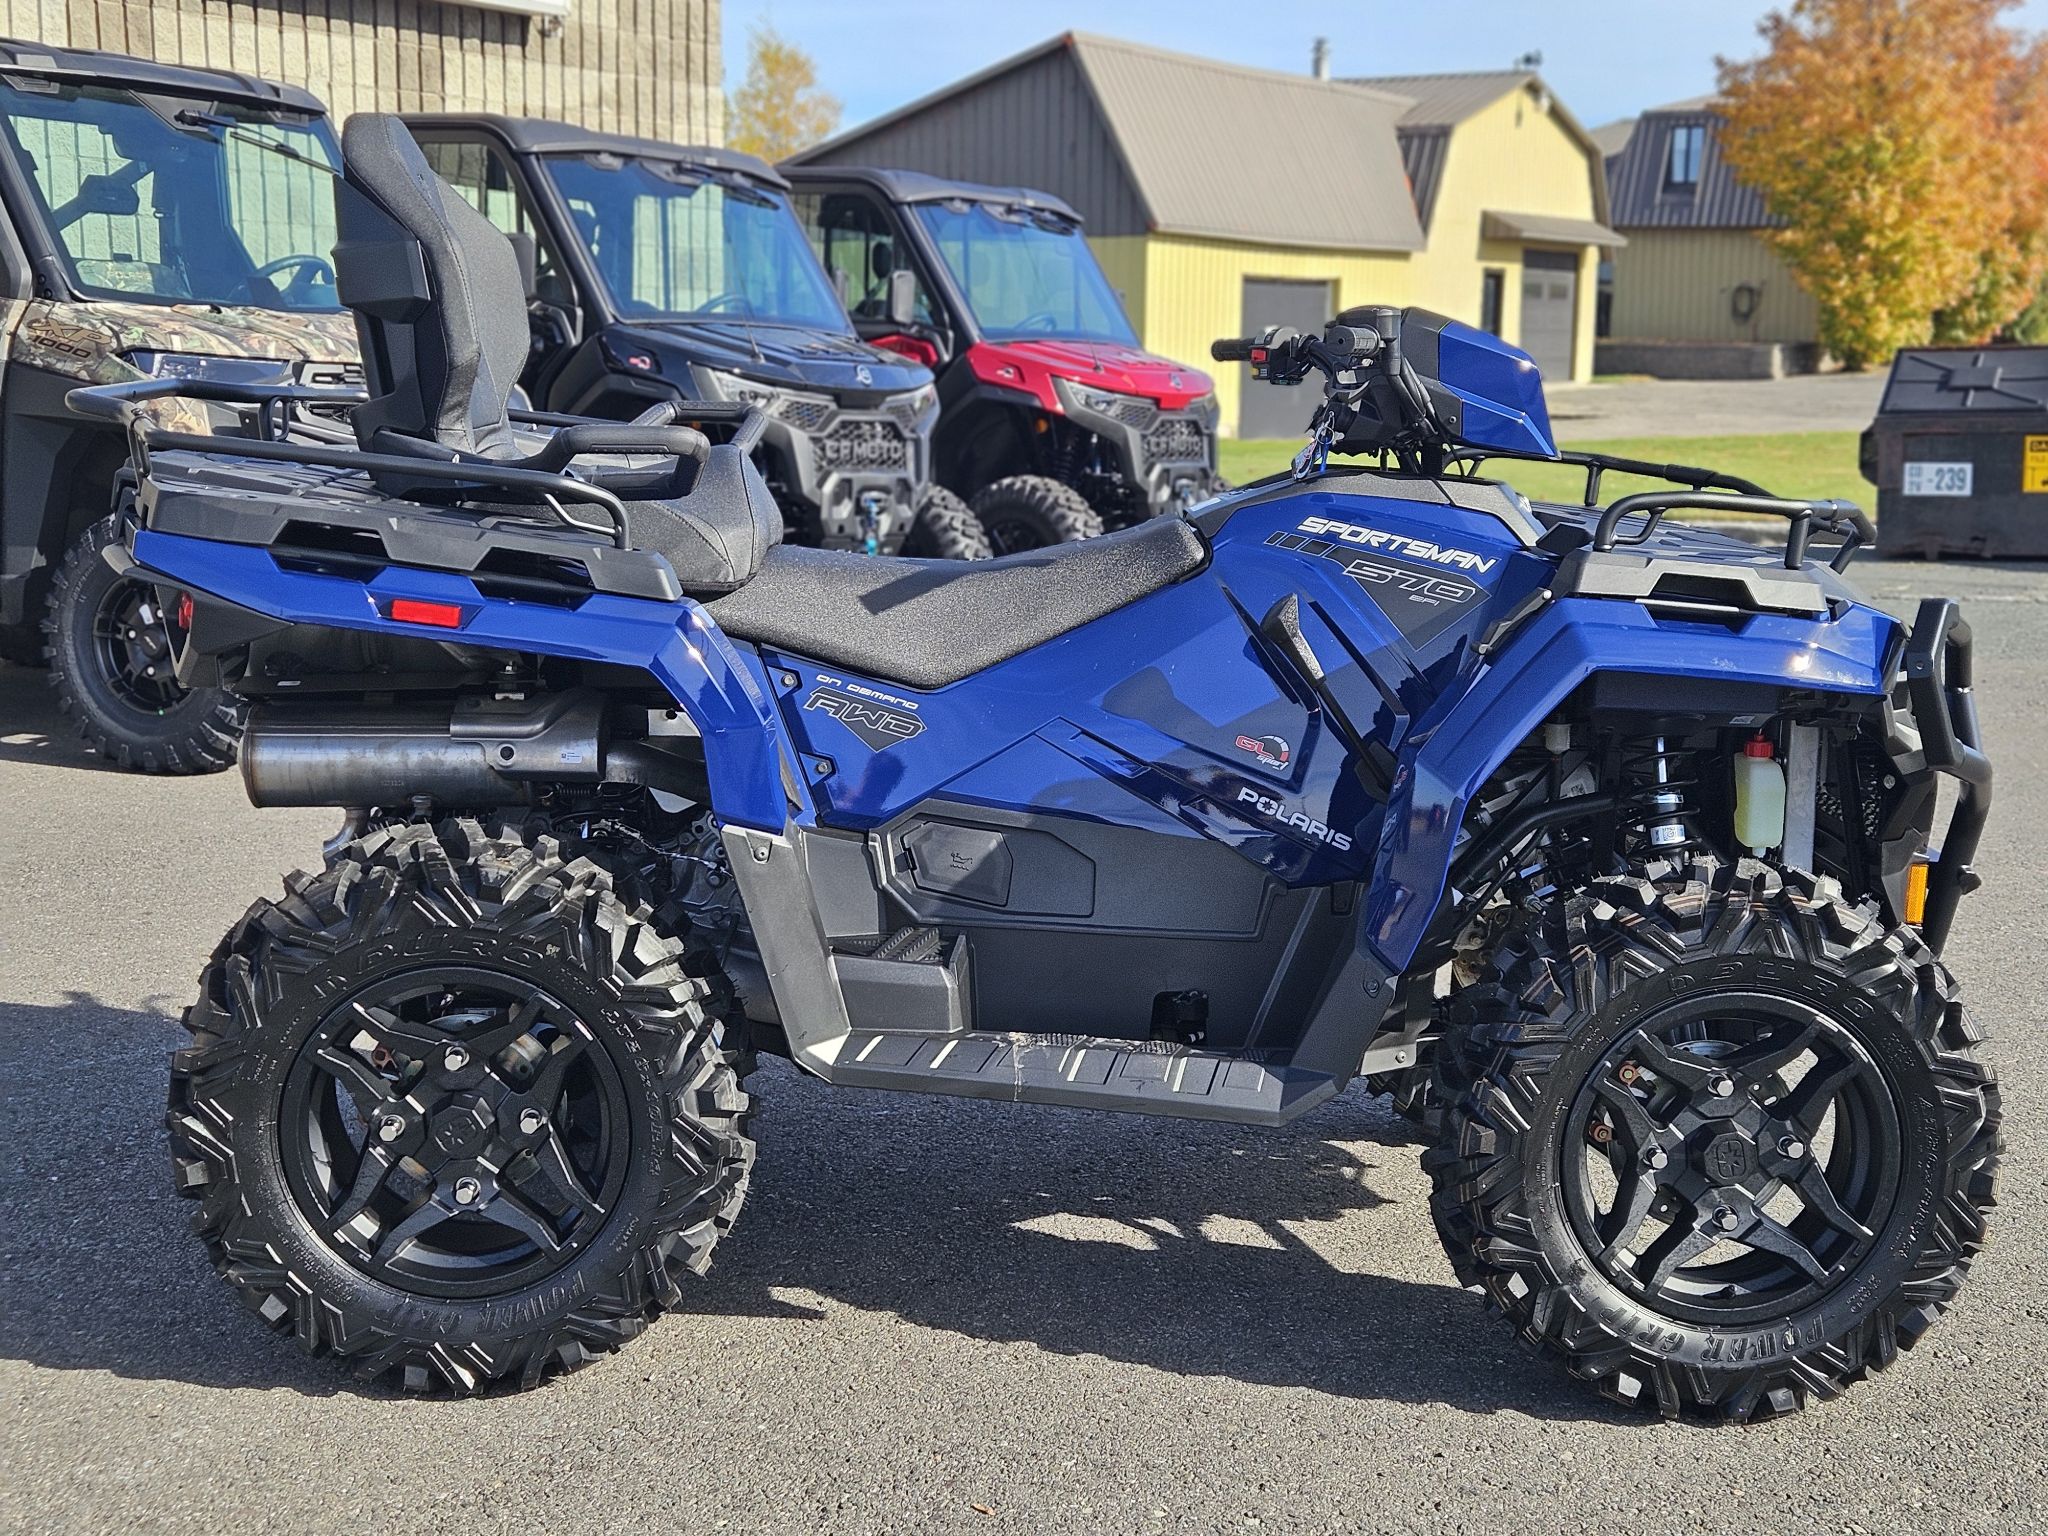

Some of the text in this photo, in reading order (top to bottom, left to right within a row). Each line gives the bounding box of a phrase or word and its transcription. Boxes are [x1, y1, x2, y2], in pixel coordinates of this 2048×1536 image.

[28, 317, 113, 346] XP
[32, 335, 92, 359] 1000
[825, 439, 904, 460] CFMOTO
[1296, 516, 1497, 573] SPORTSMAN
[1342, 559, 1476, 602] 570
[1408, 594, 1440, 606] EFI
[803, 692, 923, 738] AWD
[1237, 786, 1353, 851] POLARIS
[1599, 1305, 1825, 1362] POWER GRIP
